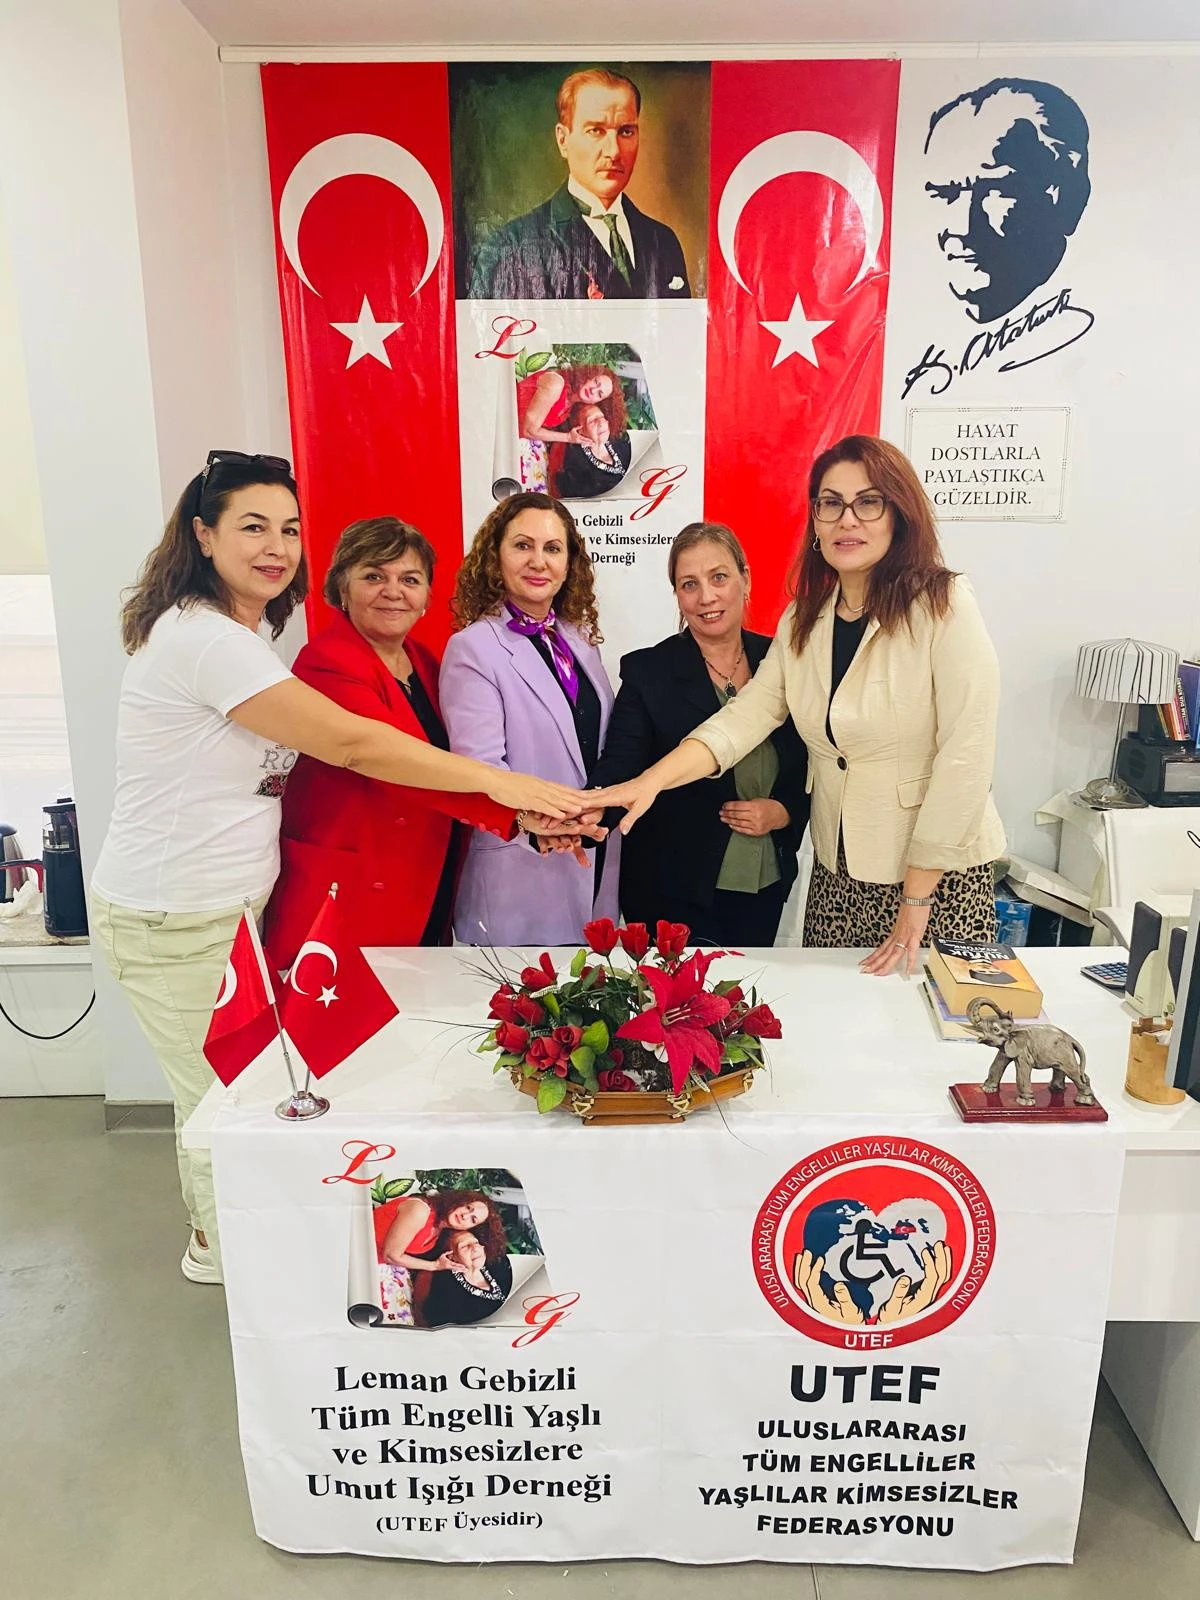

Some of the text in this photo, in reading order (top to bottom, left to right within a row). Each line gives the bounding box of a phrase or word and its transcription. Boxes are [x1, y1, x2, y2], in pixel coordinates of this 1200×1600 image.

[956, 423, 1019, 438] HAYAT
[931, 446, 1041, 461] DOSTLARLA
[924, 468, 1045, 485] PAYLAŞTIKÇA
[933, 487, 1032, 506] GÜZELDİR.
[582, 514, 623, 527] Gebizli
[589, 536, 602, 545] ve
[590, 551, 636, 567] Derneği
[948, 949, 1010, 960] NUTUK
[757, 1142, 991, 1311] ULUSLARARASI TÜM ENGELLİLER YAŞLILAR KİMSESİZLER FEDERASYONU
[844, 1333, 894, 1348] UTEF
[334, 1365, 577, 1393] Leman Gebizli
[790, 1364, 941, 1404] UTEF
[311, 1402, 602, 1433] Tüm Engelli Yaşlı
[757, 1419, 967, 1443] ULUSLARARASI
[331, 1438, 584, 1465] ve Kimsesizlere
[742, 1449, 976, 1473] TÜM ENGELLİLER
[305, 1473, 613, 1506] Umut Işığı Derneği
[698, 1481, 1018, 1510] YAŞLILAR KİMSESİZLER
[375, 1510, 544, 1534] (UTEF Üyesidir)
[757, 1514, 955, 1537] FEDERASYONU
